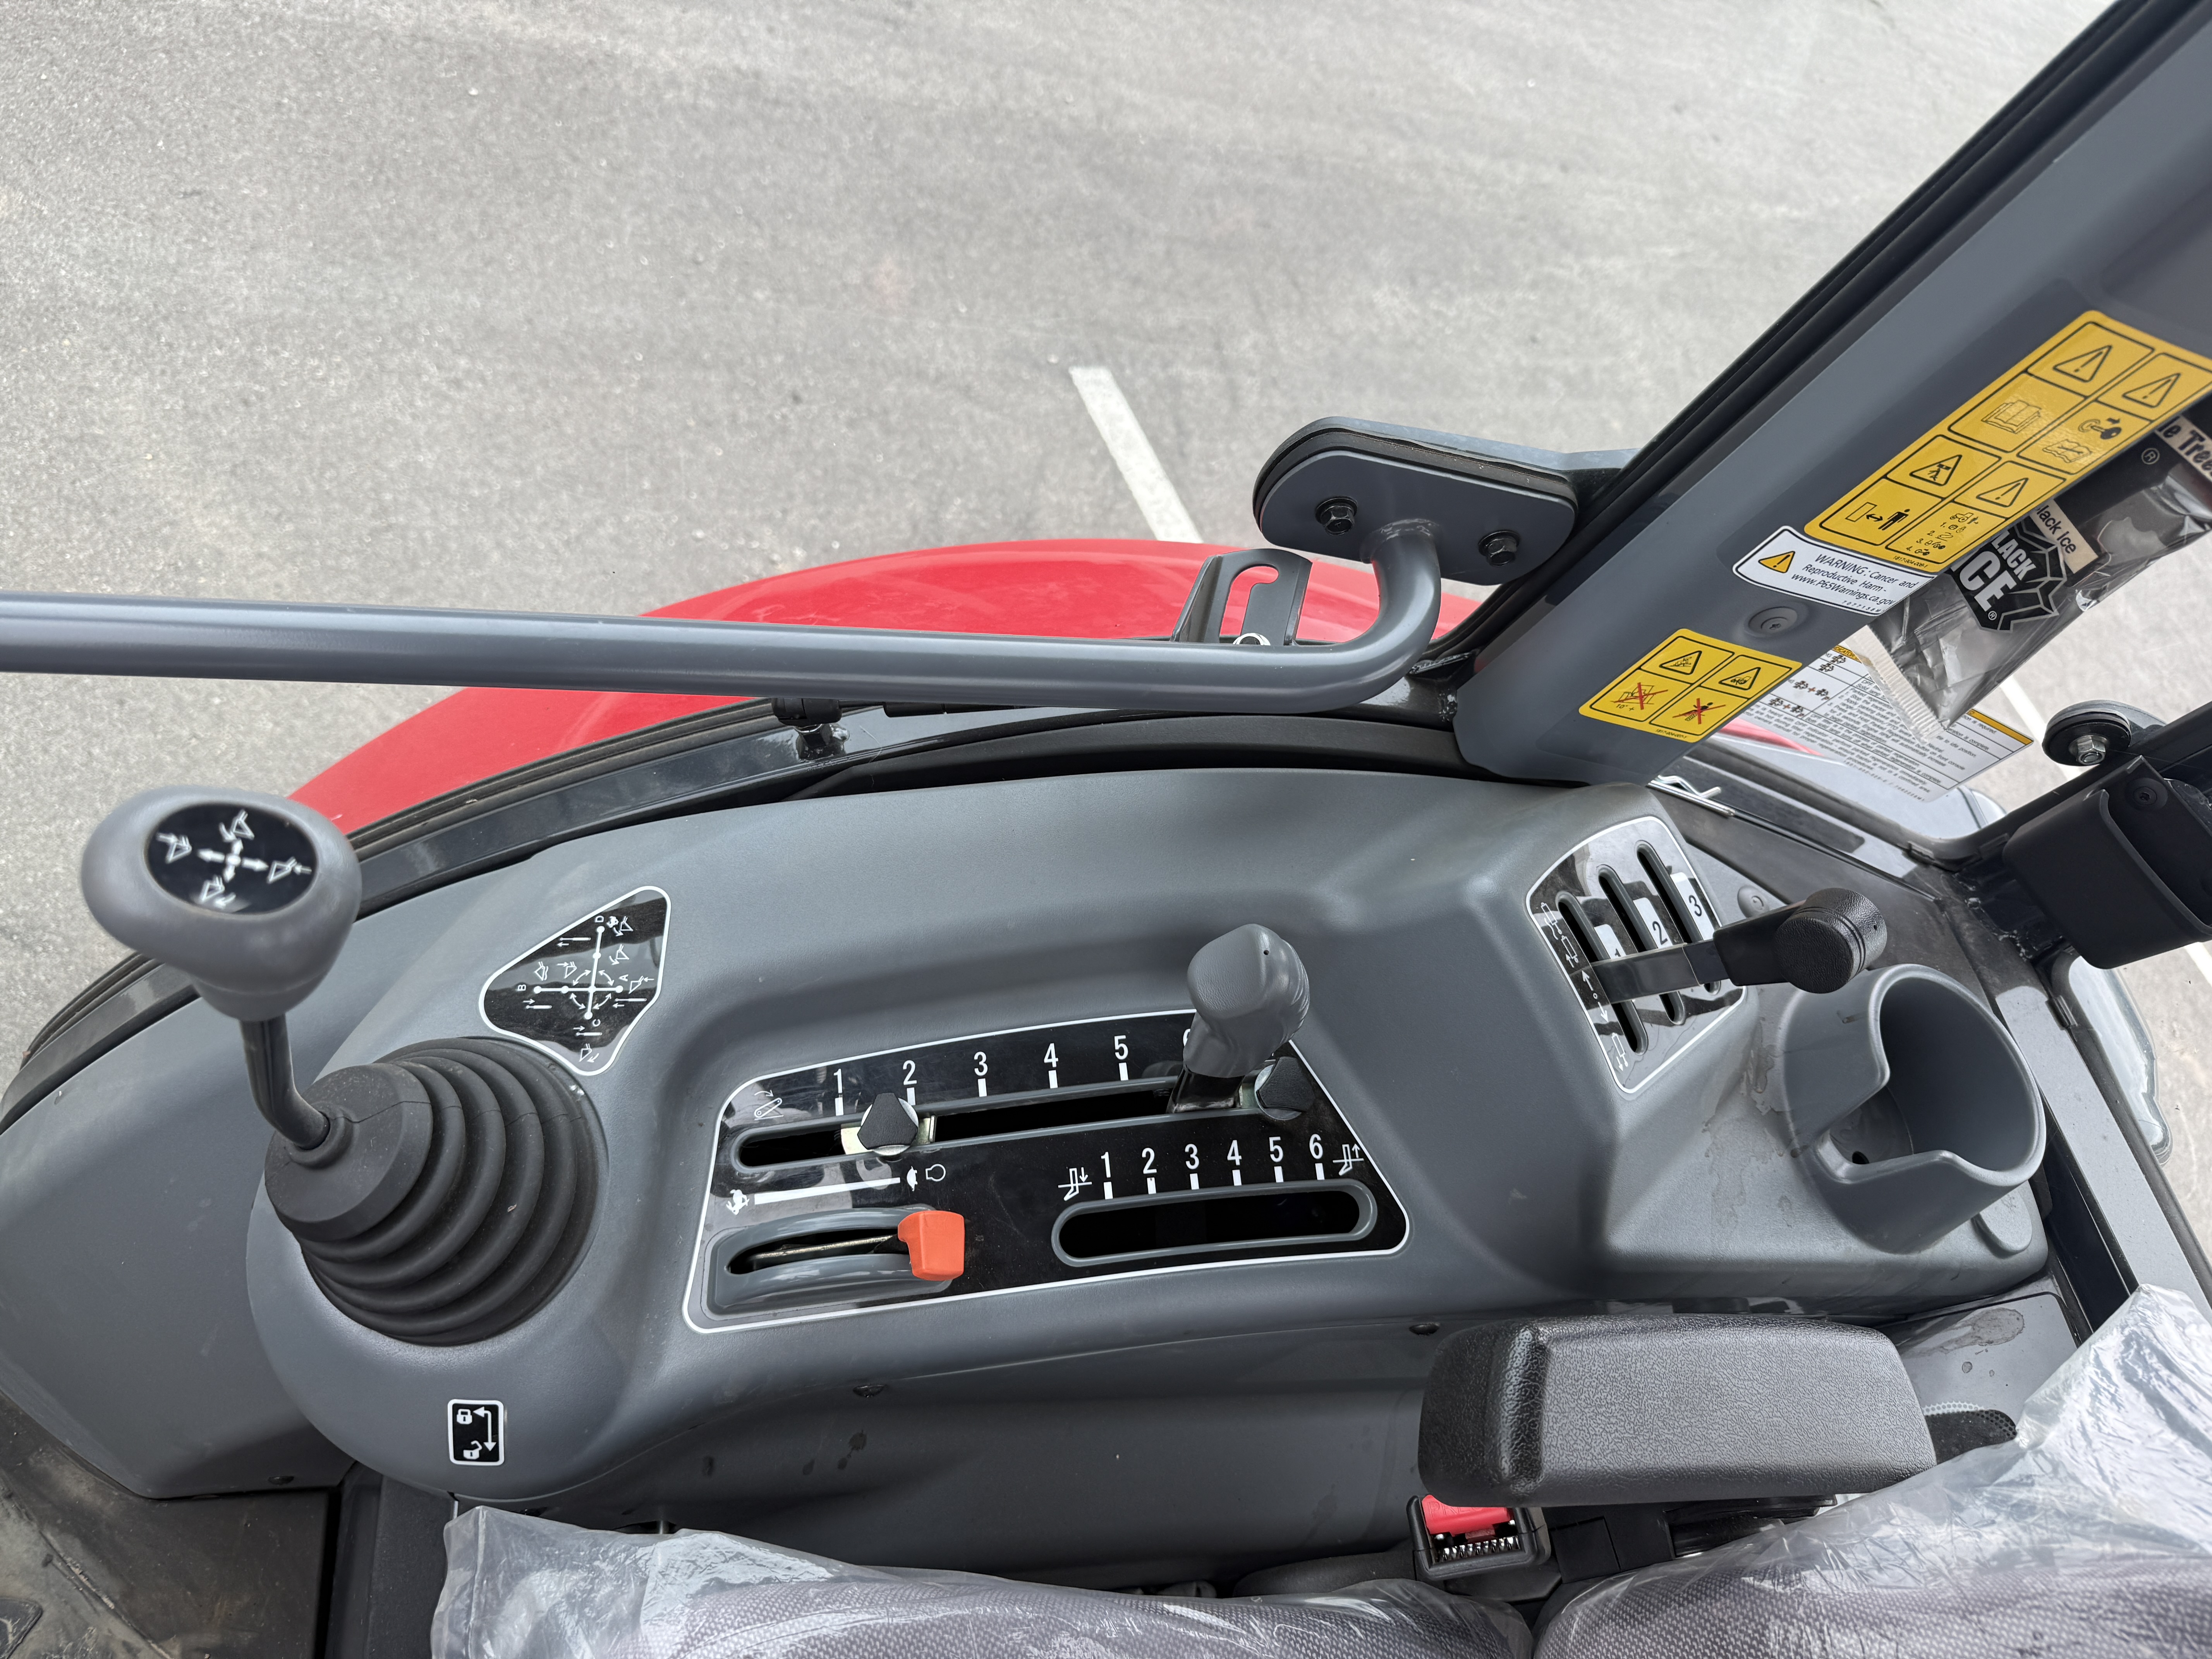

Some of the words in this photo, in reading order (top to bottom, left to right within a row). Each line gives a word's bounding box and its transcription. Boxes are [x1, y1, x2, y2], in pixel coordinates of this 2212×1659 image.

[2178, 430, 2212, 477] Tree
[2035, 505, 2062, 534] lack
[2056, 531, 2076, 554] Ice
[1992, 529, 2037, 580] LACK
[1791, 574, 1896, 605] www.P65Warnings.ca.gov
[1802, 564, 1858, 585] Reproductive
[1860, 581, 1883, 592] Harm
[1869, 572, 1898, 584] Cancer
[1899, 580, 1919, 589] and
[1688, 895, 1702, 917] 3
[1652, 921, 1668, 945] 2
[592, 1019, 601, 1027] C
[833, 1068, 842, 1094] 1
[903, 1060, 917, 1085] 2
[974, 1051, 988, 1076] 3
[1044, 1043, 1058, 1067] 4
[1114, 1035, 1128, 1060] 5
[1101, 1152, 1111, 1178] 1
[1142, 1147, 1157, 1174] 2
[1185, 1144, 1199, 1170] 3
[1227, 1140, 1242, 1165] 4
[1269, 1137, 1283, 1162] 5
[1309, 1134, 1323, 1159] 6
